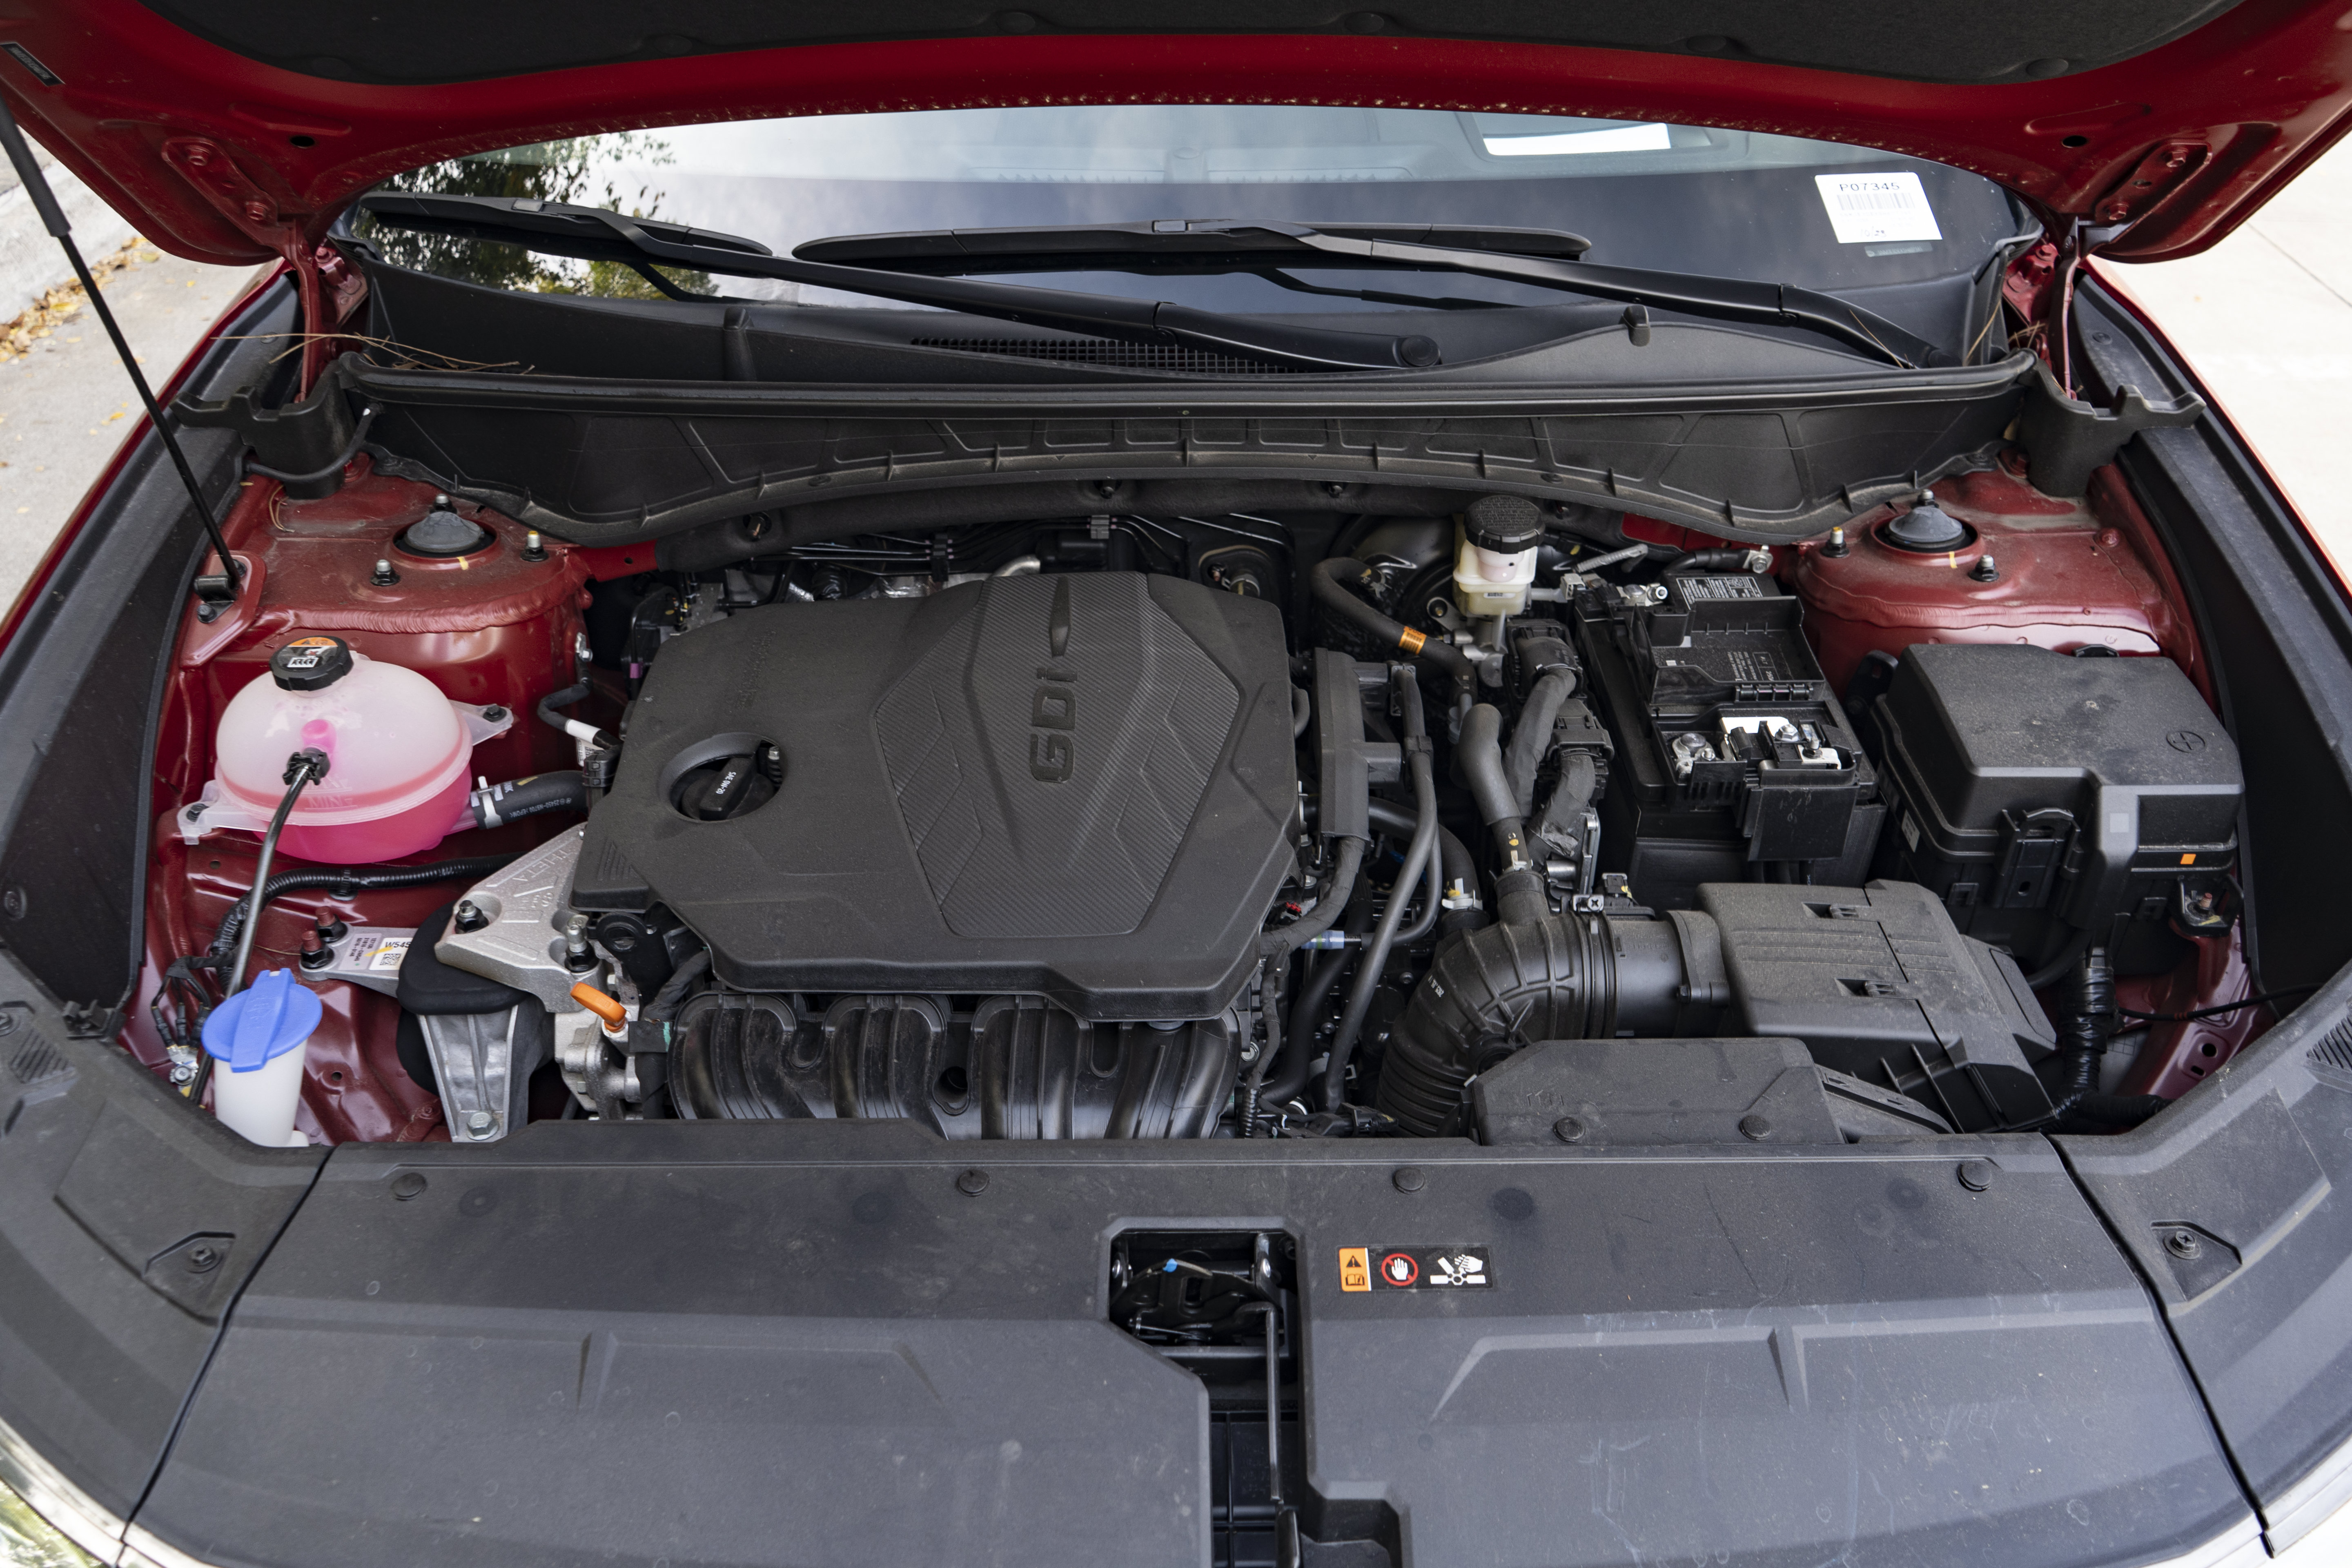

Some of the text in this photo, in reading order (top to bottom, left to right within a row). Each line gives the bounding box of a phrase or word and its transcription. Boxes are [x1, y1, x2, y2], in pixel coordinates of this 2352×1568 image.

[1839, 182, 1900, 192] P07345
[715, 771, 737, 795] SAE 0W-20
